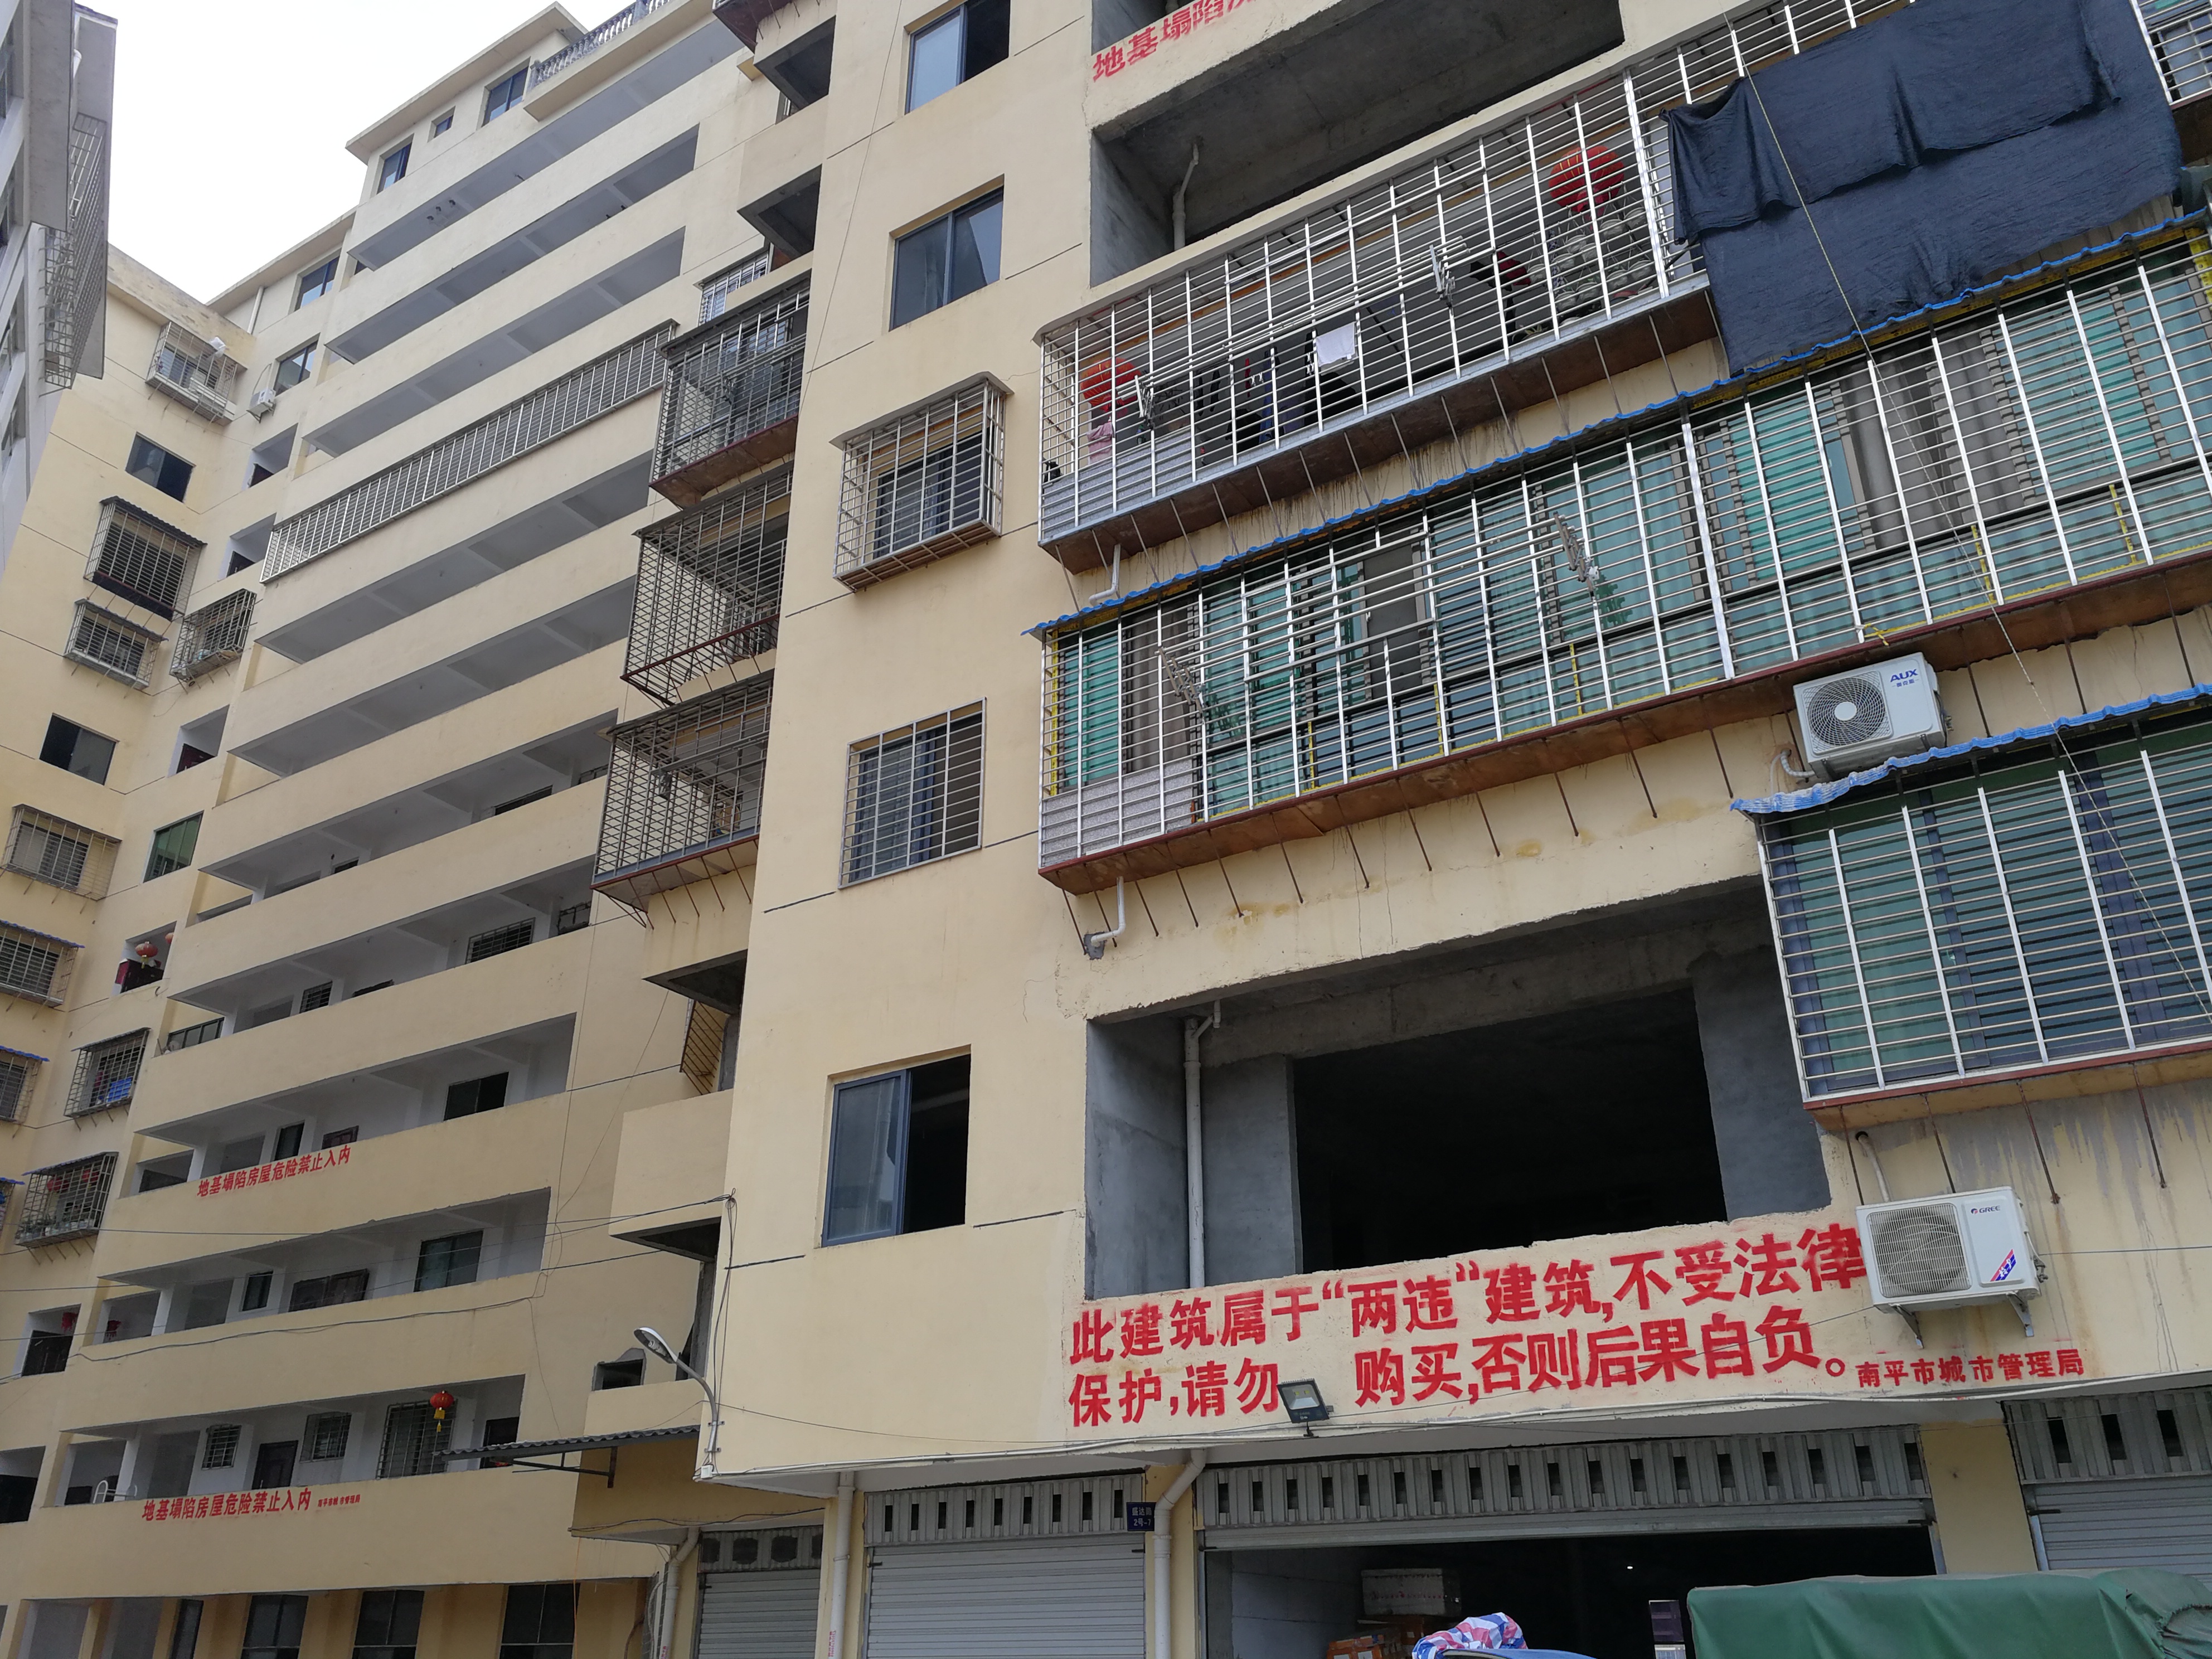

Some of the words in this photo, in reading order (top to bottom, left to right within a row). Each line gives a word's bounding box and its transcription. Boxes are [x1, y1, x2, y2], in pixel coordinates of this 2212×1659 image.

[1890, 668, 1918, 682] AUX
[197, 1144, 351, 1197] 地基塌陷房屋危险禁止入内
[1979, 1205, 2001, 1214] GREE
[1855, 1348, 2085, 1388] 南平市城市管理局
[142, 1487, 312, 1521] 地基塌陷房屋危险禁止入内
[1133, 1517, 1151, 1527] 2号-7
